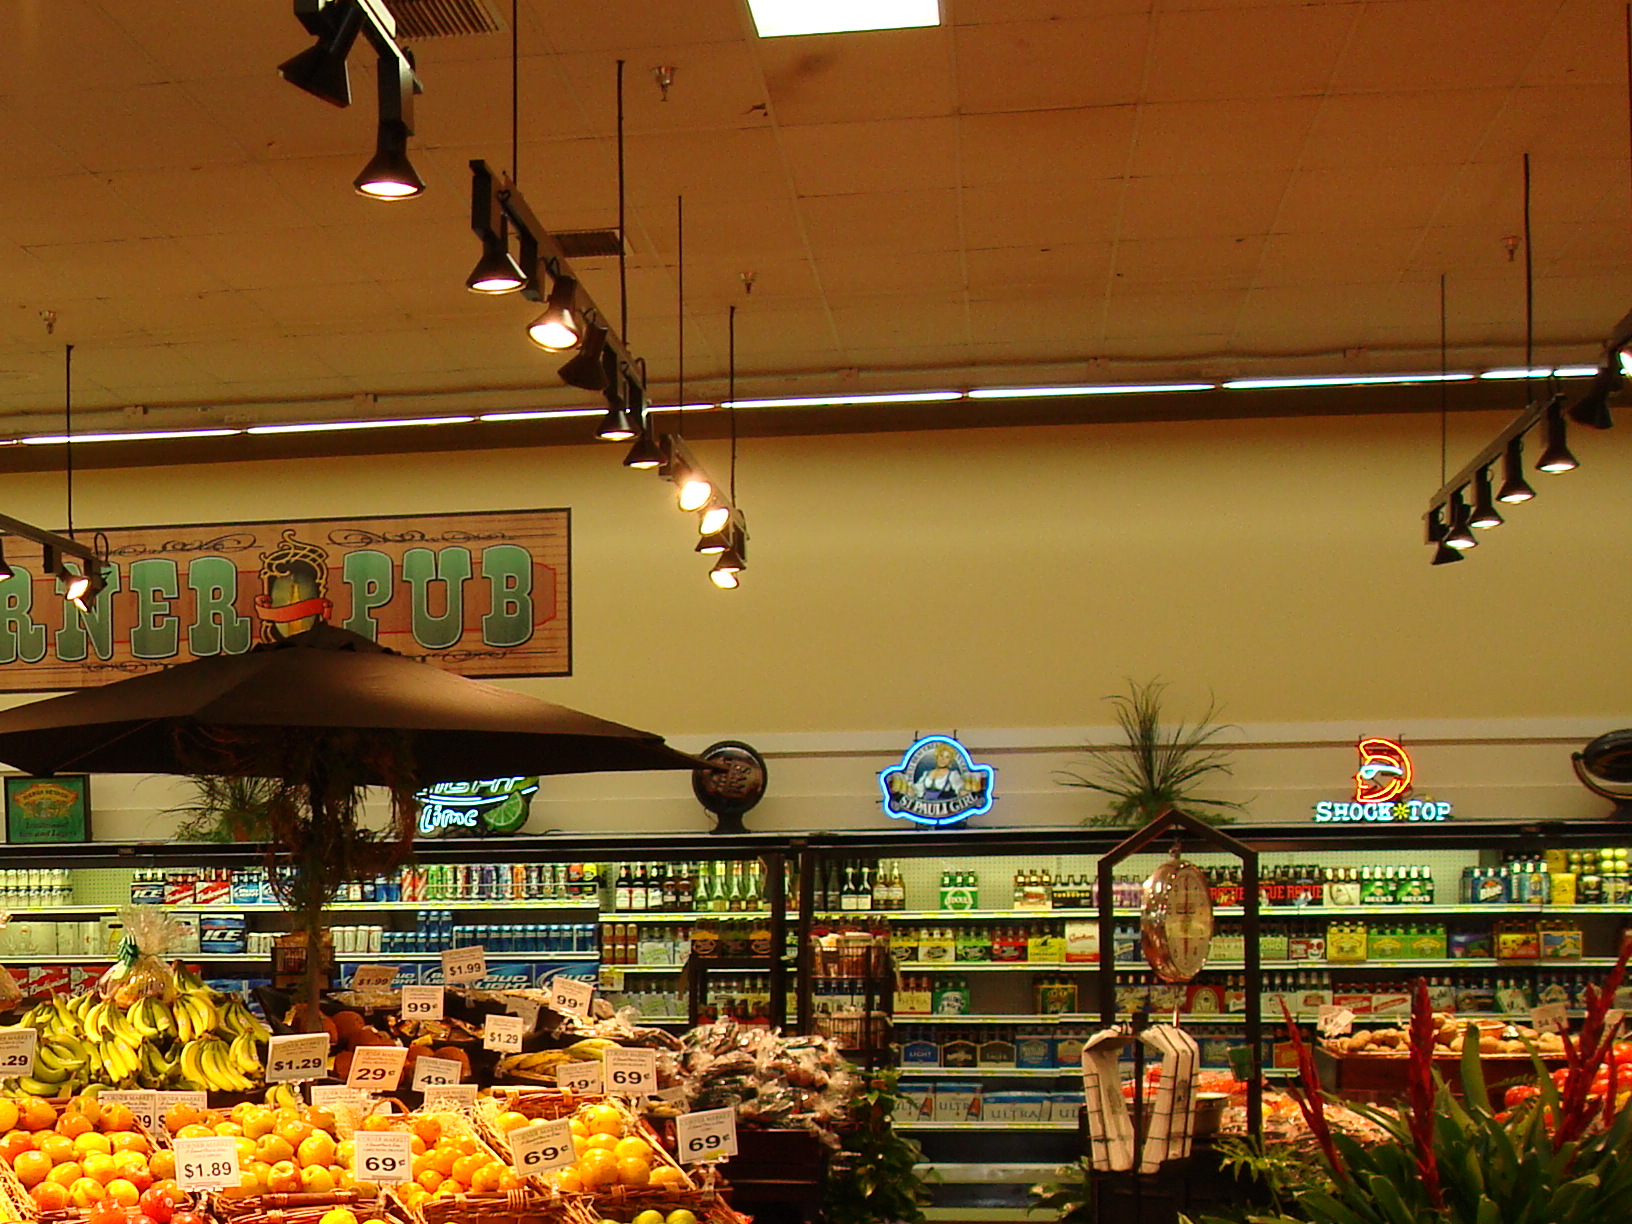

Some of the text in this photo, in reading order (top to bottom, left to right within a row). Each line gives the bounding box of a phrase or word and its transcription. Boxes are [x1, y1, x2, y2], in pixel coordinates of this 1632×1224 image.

[342, 543, 536, 650] PUB
[913, 801, 948, 815] PAULI
[949, 793, 979, 812] GIRL
[1315, 800, 1452, 822] SHOCK TOP
[419, 804, 479, 833] Lime
[132, 889, 162, 898] ICE
[1480, 884, 1503, 901] Blue
[202, 930, 243, 941] ICE
[449, 962, 482, 977] $1.99
[357, 976, 388, 986] $1.99
[487, 974, 528, 982] BUD
[407, 1002, 438, 1013] 99¢
[556, 995, 585, 1010] 99¢
[489, 1032, 518, 1045] $1.29
[274, 1058, 322, 1071] $1.29
[356, 1067, 396, 1081] 29¢
[613, 1070, 650, 1085] 69¢
[991, 1110, 1039, 1119] ULTRA
[689, 1133, 730, 1152] 69¢
[524, 1145, 569, 1165] 69¢
[184, 1161, 231, 1179] $1.89
[365, 1156, 406, 1172] 69¢
